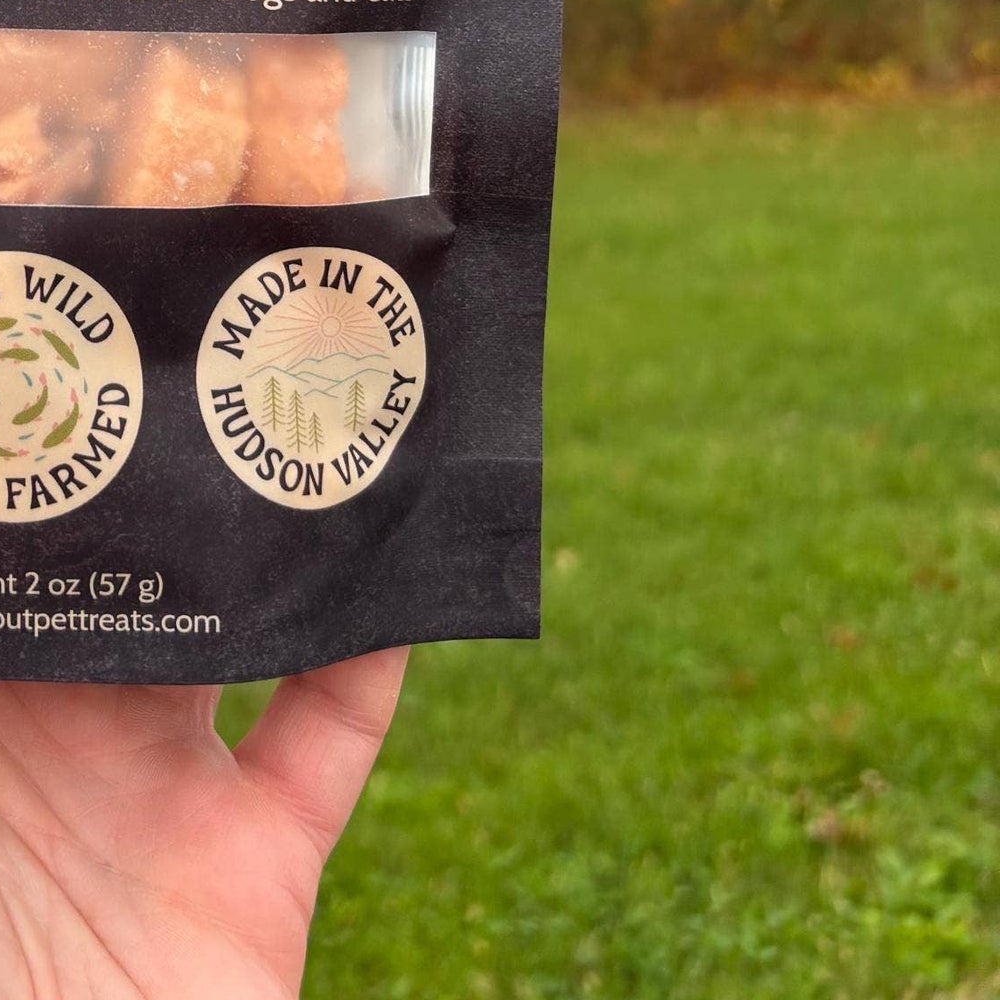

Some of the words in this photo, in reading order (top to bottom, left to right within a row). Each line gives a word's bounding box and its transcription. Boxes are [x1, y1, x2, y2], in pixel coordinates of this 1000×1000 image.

[24, 265, 115, 344] WILD
[212, 258, 307, 360] MADE
[319, 259, 363, 294] IN
[367, 275, 416, 347] THE
[5, 382, 130, 510] FARMED
[211, 384, 325, 496] HUDSON
[331, 368, 417, 486] VALLEY
[25, 572, 40, 595] 2
[48, 577, 80, 595] oz
[89, 573, 131, 600] (57
[138, 572, 164, 603] g)
